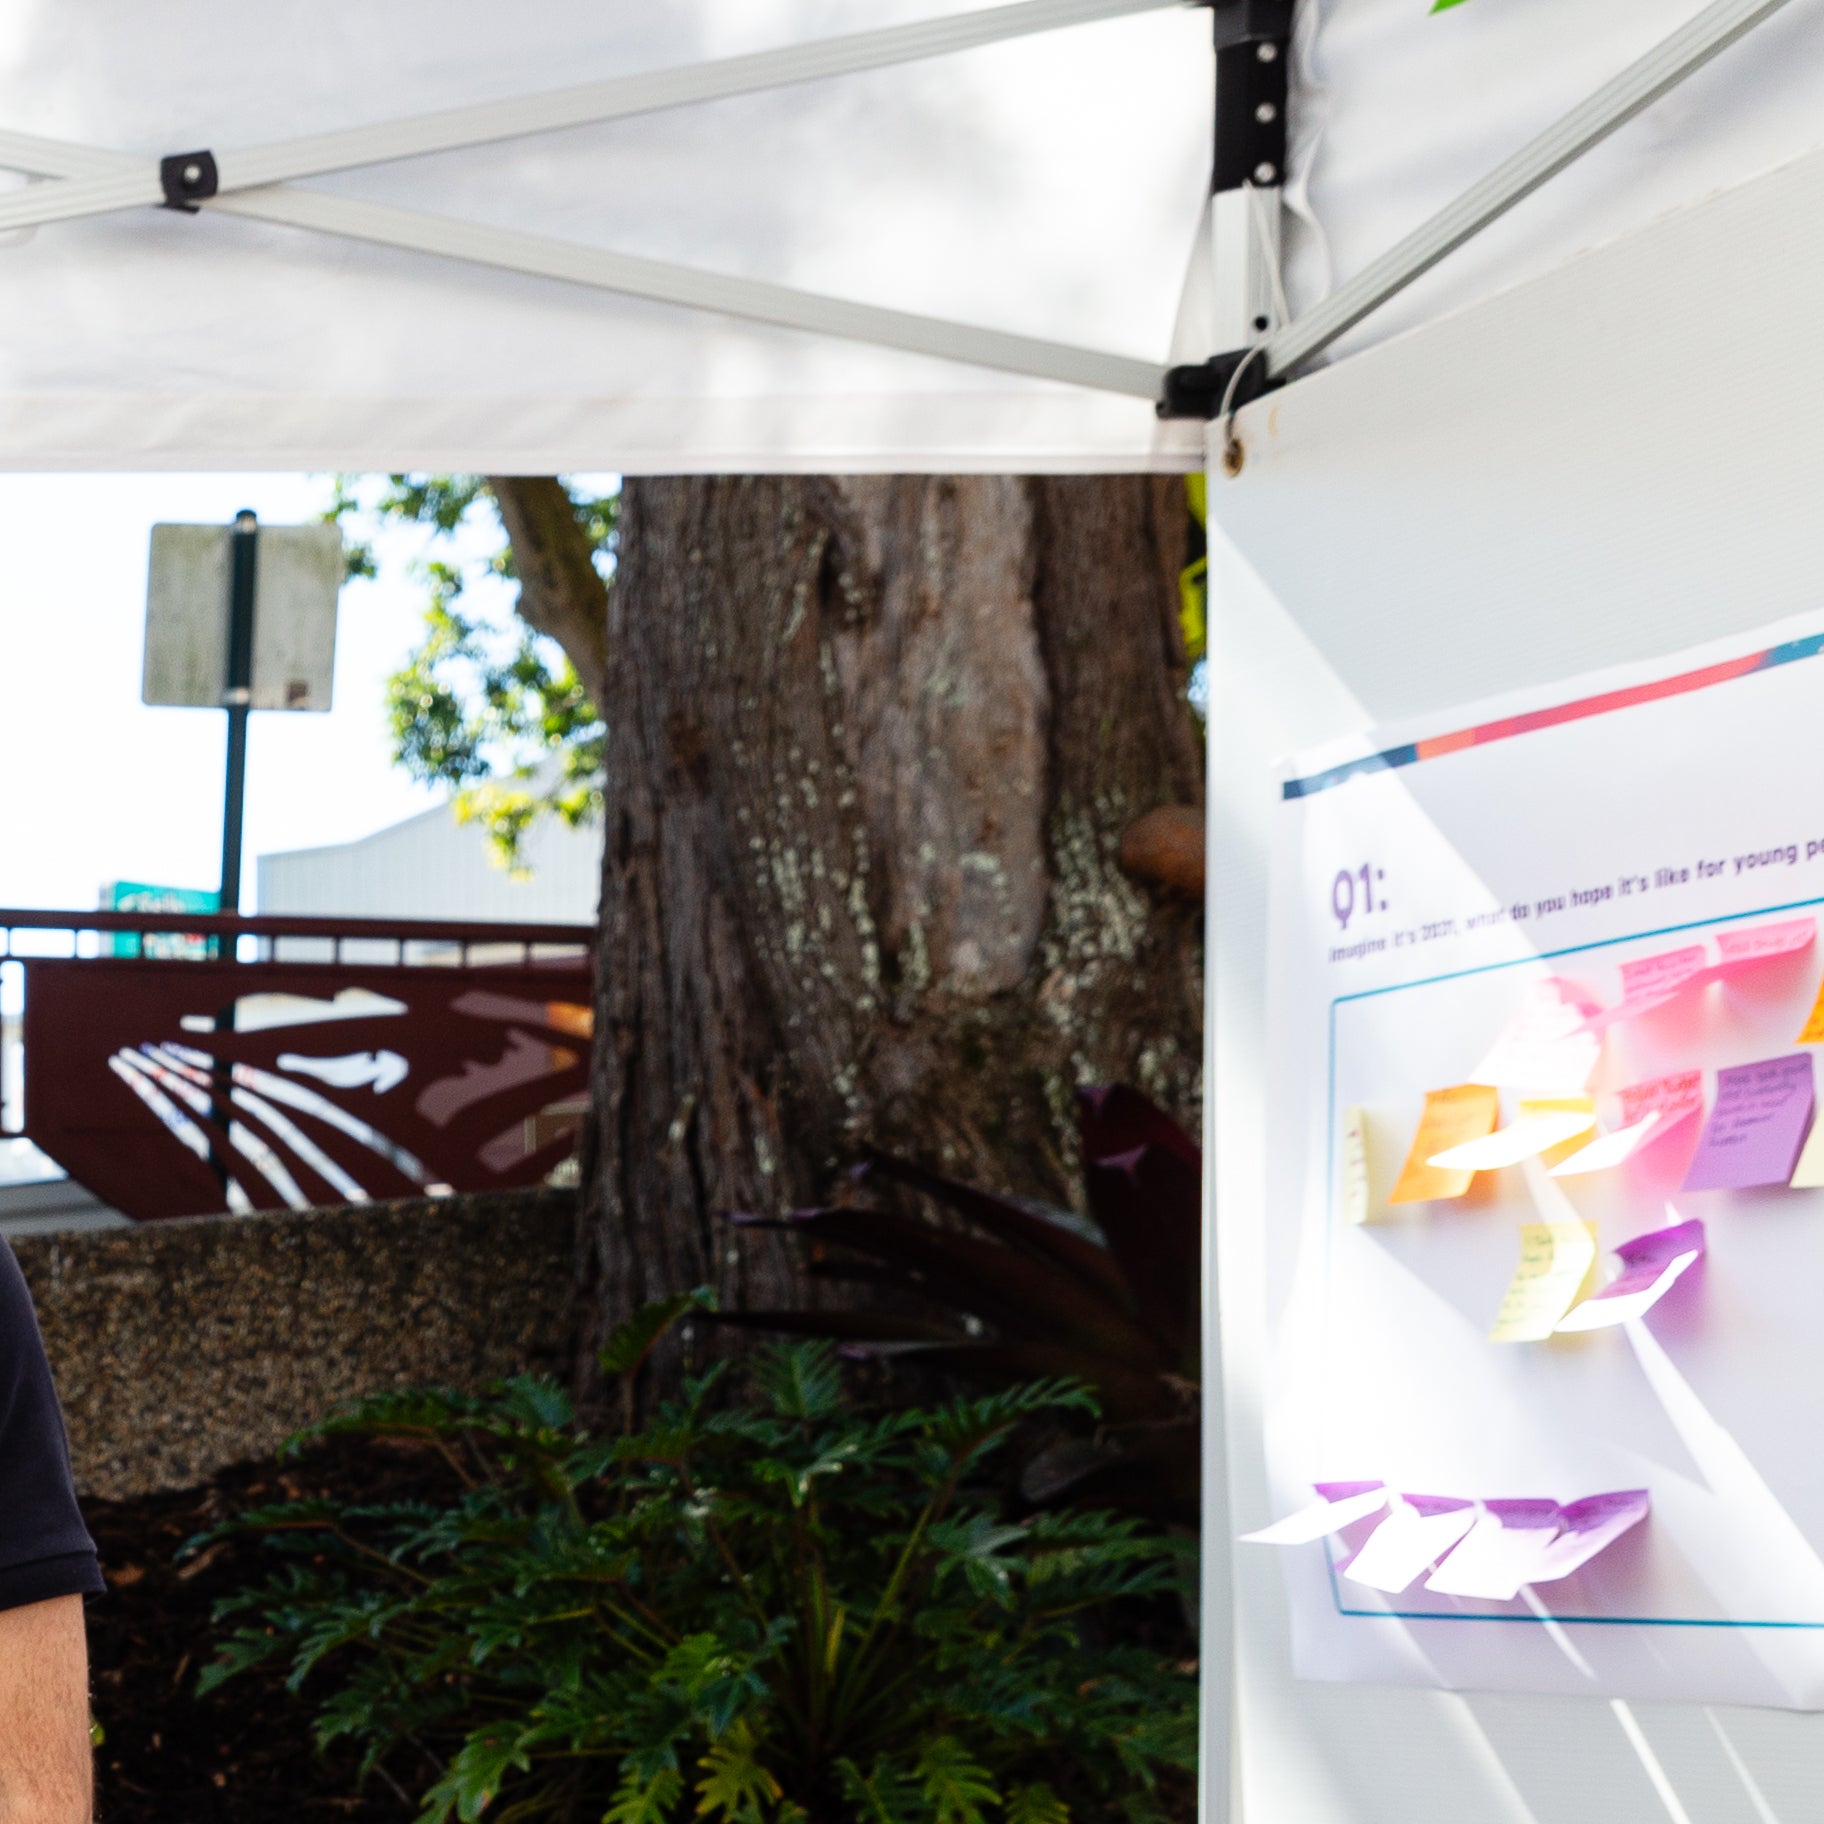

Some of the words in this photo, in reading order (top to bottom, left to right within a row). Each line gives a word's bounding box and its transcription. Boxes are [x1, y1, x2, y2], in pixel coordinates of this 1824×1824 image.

[1696, 857, 1726, 880] for
[1732, 846, 1798, 877] young
[1330, 862, 1388, 931] Q1:
